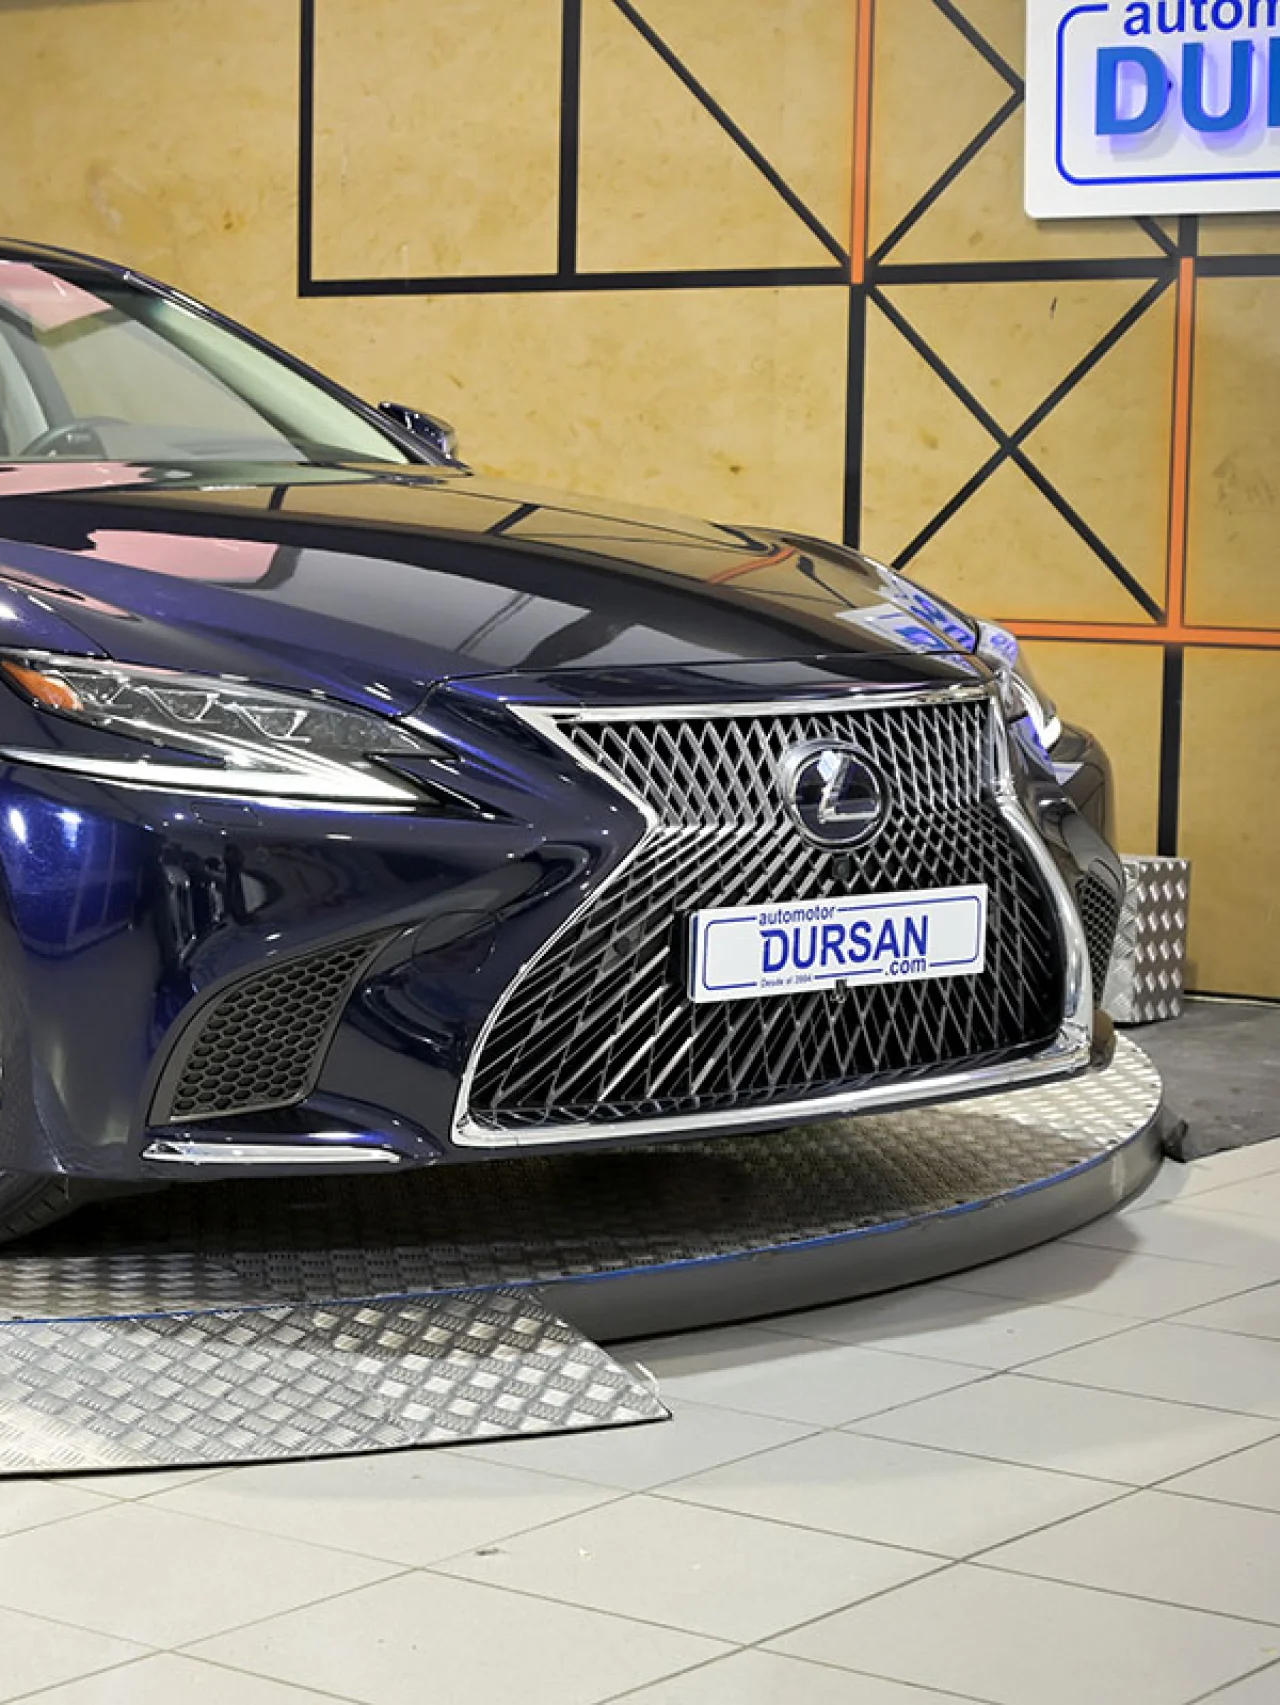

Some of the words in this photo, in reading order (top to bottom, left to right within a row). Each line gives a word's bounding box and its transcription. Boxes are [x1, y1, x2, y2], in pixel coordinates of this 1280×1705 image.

[1095, 36, 1280, 136] DU
[758, 904, 836, 926] automotor
[759, 914, 929, 974] DURSAN
[885, 957, 927, 976] .com
